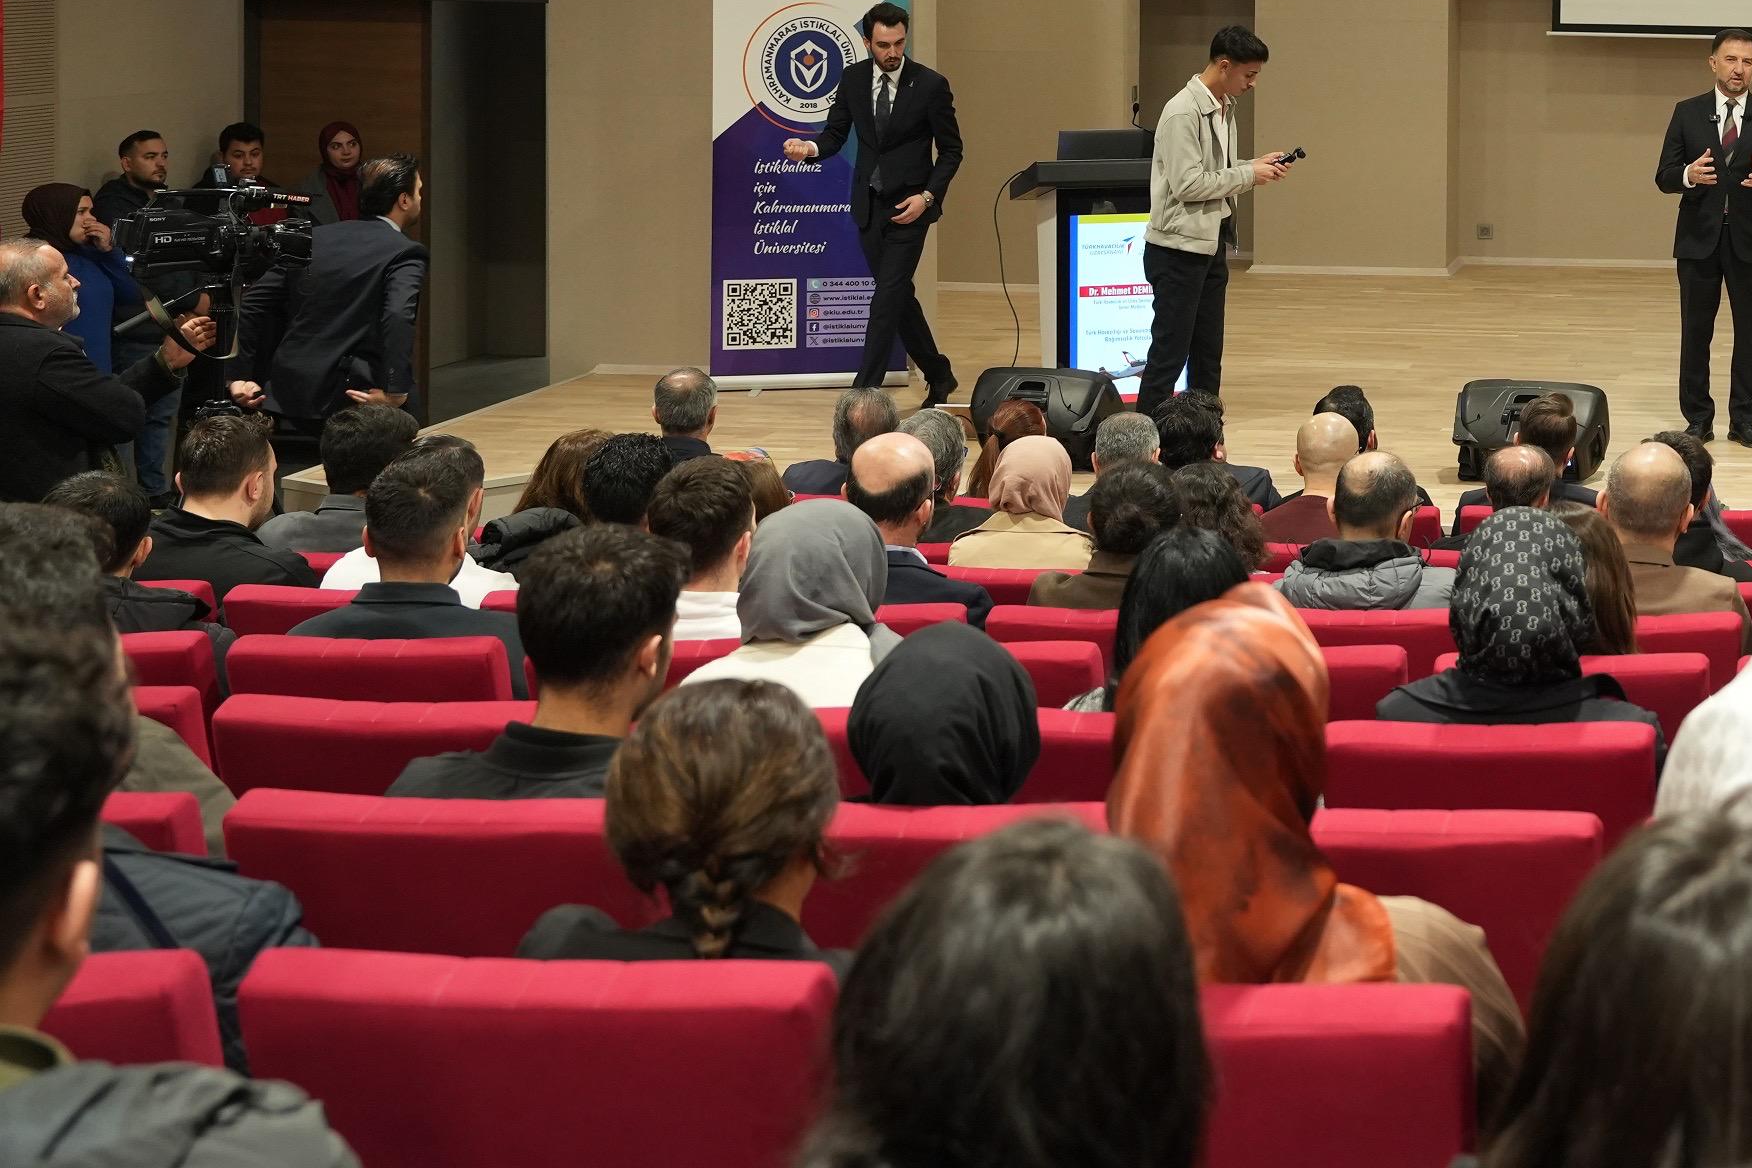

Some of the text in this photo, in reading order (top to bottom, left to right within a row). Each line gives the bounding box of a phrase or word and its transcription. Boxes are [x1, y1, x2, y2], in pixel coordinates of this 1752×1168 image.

[764, 23, 798, 104] KAHRAMANMARAŞ
[800, 20, 842, 42] İSTİKLAL
[754, 158, 823, 174] İstikbaliniz
[753, 182, 777, 198] için
[288, 195, 310, 203] HABER
[753, 200, 852, 214] Kahramanmara
[753, 219, 799, 235] İstiklal
[154, 236, 172, 244] HD
[754, 239, 827, 255] Üniversitesi
[1088, 285, 1154, 296] Dr. Mehmet DEMİ
